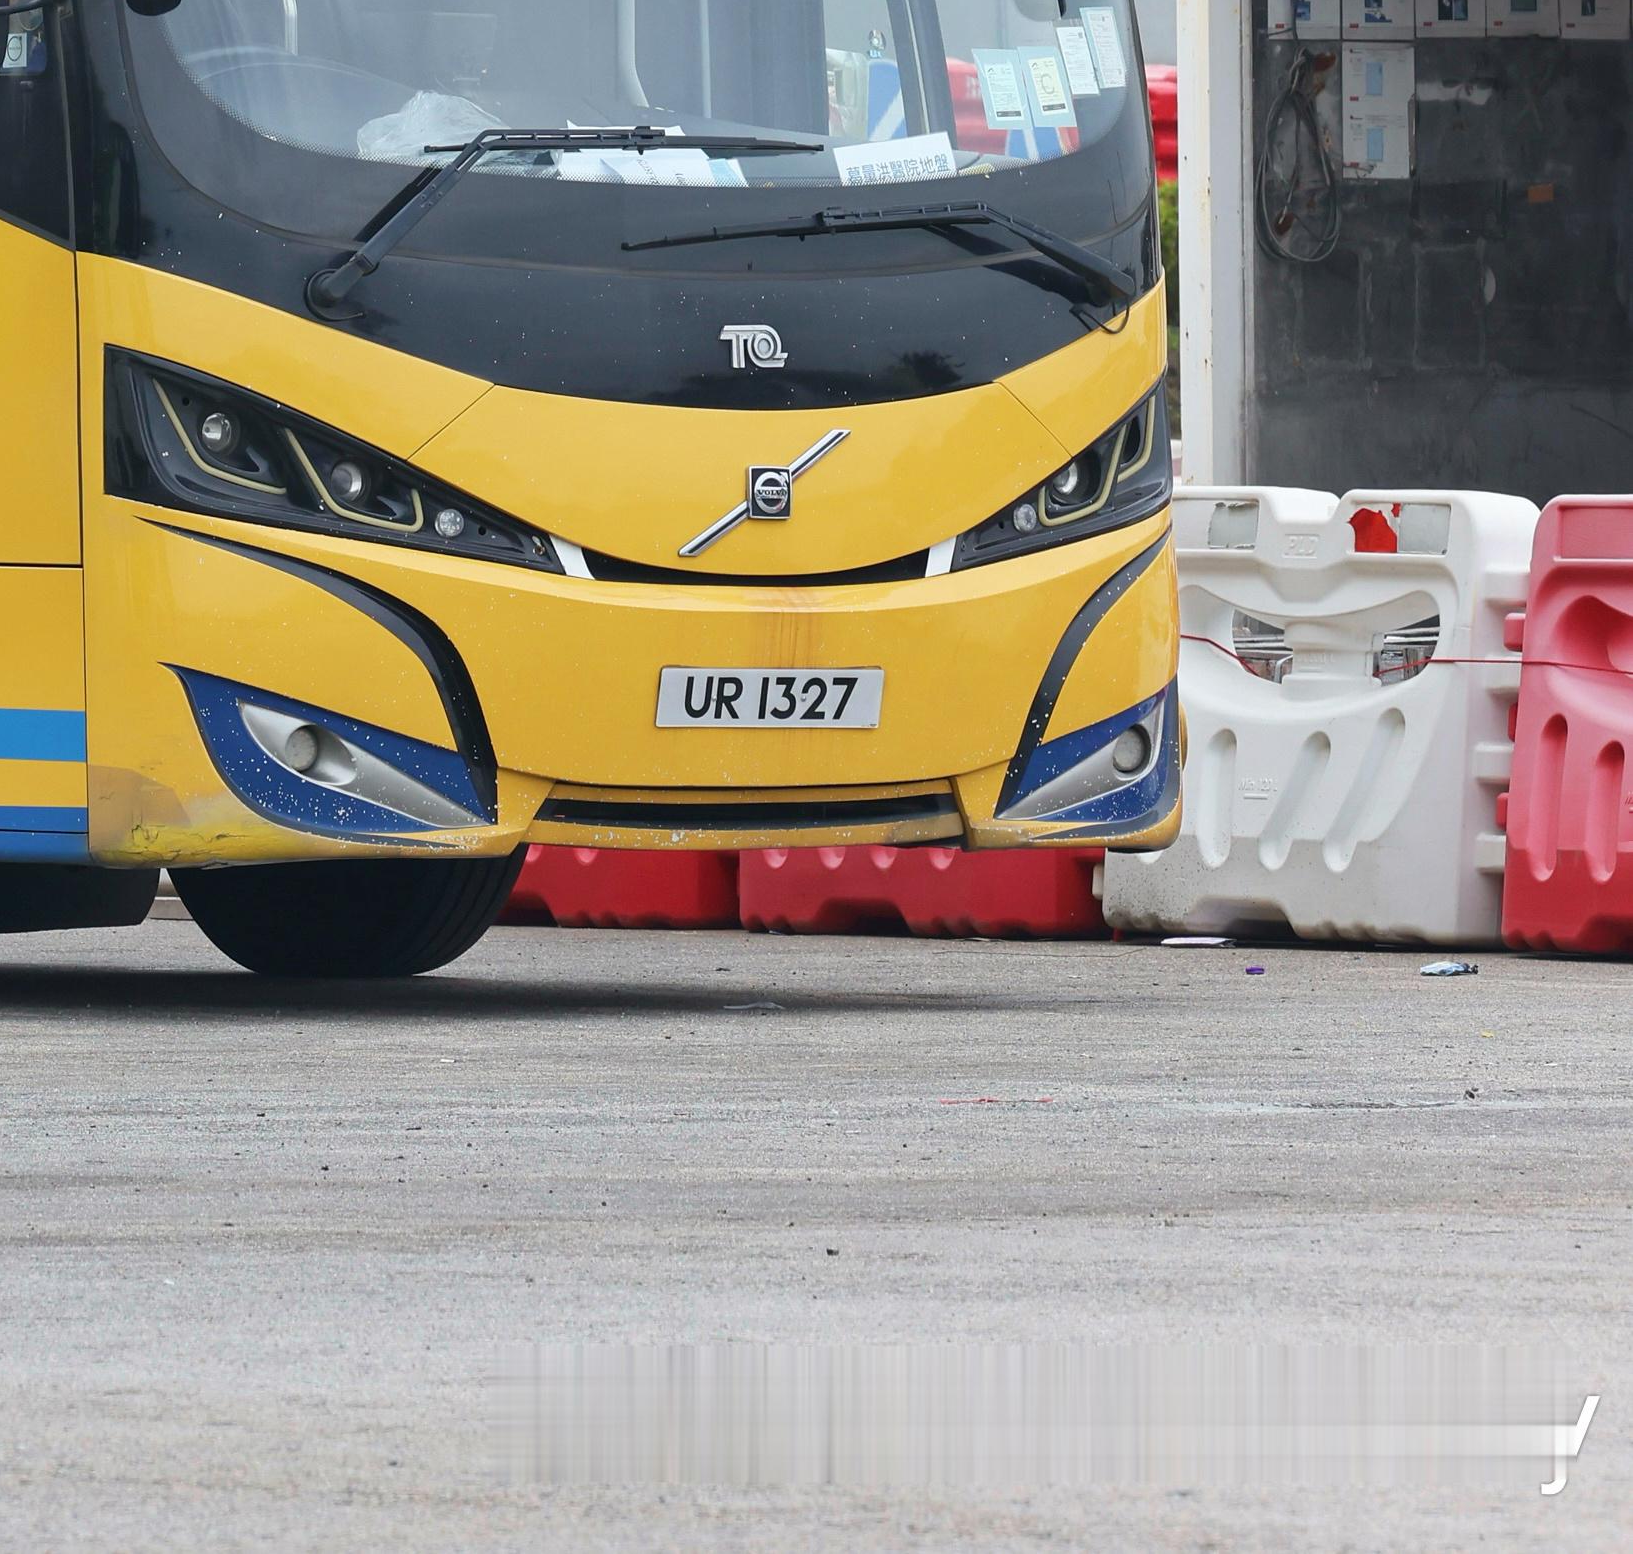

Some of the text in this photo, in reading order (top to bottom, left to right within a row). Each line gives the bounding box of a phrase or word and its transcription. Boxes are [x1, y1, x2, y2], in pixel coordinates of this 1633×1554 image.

[756, 489, 788, 497] VOLVO
[685, 675, 858, 720] UR 1327
